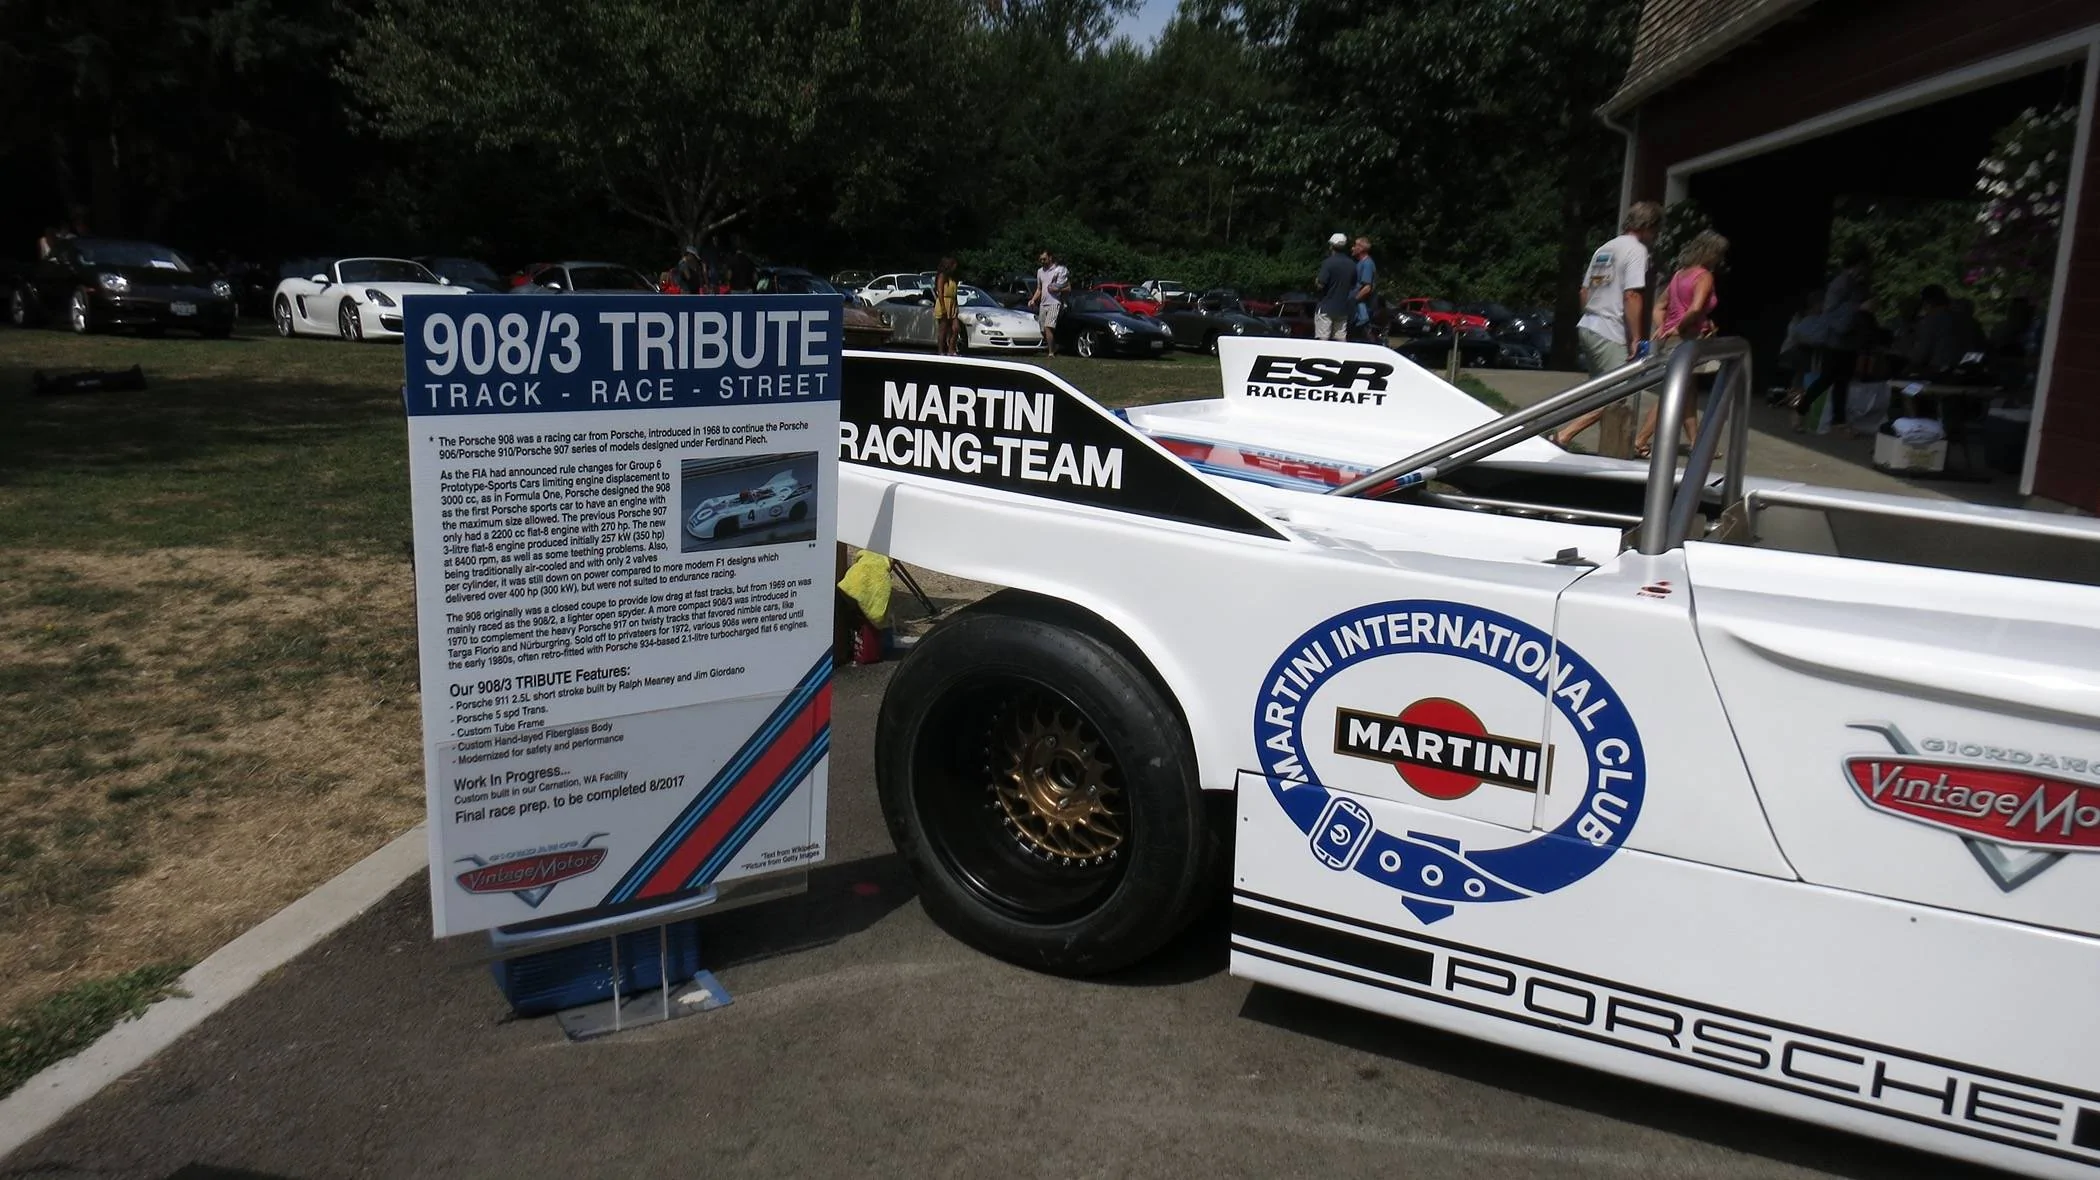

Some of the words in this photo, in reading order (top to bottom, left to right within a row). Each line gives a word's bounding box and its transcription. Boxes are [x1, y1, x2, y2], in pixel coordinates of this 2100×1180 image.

[423, 310, 582, 376] 908/3
[599, 310, 830, 371] TRIBUTE
[1247, 355, 1394, 391] ESR
[425, 381, 542, 408] TRACK
[591, 378, 675, 404] RACE
[718, 373, 830, 399] STREET
[1246, 384, 1387, 405] RACECRAFT
[883, 380, 1054, 434] MARTINI
[438, 437, 457, 447] The
[458, 435, 497, 447] Porsche
[497, 434, 515, 445] 908
[516, 435, 535, 444] was
[544, 432, 572, 443] racing
[572, 433, 587, 442] car
[588, 430, 609, 441] from
[648, 426, 692, 438] introduced
[692, 426, 701, 436] in
[702, 425, 721, 436] 1968
[722, 425, 731, 435] to
[731, 423, 765, 434] continue
[765, 422, 778, 432] the
[779, 421, 809, 431] Porsche
[439, 448, 496, 460] 906/Porsche
[497, 445, 552, 458] 910/Porsche
[553, 444, 570, 455] 907
[571, 443, 597, 454] series
[598, 442, 608, 453] of
[609, 441, 640, 452] models
[641, 438, 679, 451] designed
[680, 437, 704, 449] under
[705, 435, 744, 447] Ferdinand
[508, 464, 558, 477] announced
[577, 463, 614, 474] changes
[838, 421, 1123, 490] RACING-TEAM
[440, 479, 518, 494] Prototype-Sports
[542, 476, 574, 488] limiting
[575, 474, 605, 486] engine
[605, 471, 661, 484] displacement
[504, 490, 541, 502] Formula
[564, 487, 600, 498] Porsche
[601, 484, 640, 496] designed
[459, 518, 503, 529] maximum
[580, 510, 616, 523] previous
[617, 507, 651, 519] Porsche
[491, 503, 528, 515] Porsche
[529, 502, 558, 514] sports
[619, 495, 648, 507] engine
[443, 545, 470, 555] 3-litre
[471, 542, 494, 553] flat-8
[495, 540, 526, 553] engine
[527, 536, 569, 551] produced
[569, 535, 600, 546] initially
[527, 526, 549, 537] flat-8
[550, 524, 580, 536] engine
[471, 564, 523, 577] traditionally
[524, 560, 568, 573] air-cooled
[632, 553, 658, 564] valves
[570, 546, 605, 558] teething
[610, 564, 652, 578] compared
[684, 559, 715, 571] modern
[726, 555, 756, 566] designs
[445, 591, 487, 604] delivered
[633, 575, 658, 587] suited
[669, 572, 710, 583] endurance
[446, 623, 477, 635] mainly
[567, 612, 594, 624] lighter
[678, 599, 711, 612] compact
[750, 589, 789, 603] introduced
[483, 607, 523, 620] originally
[551, 601, 580, 613] closed
[618, 595, 649, 607] provide
[480, 629, 534, 644] complement
[578, 621, 612, 633] Porsche
[707, 606, 736, 619] favored
[617, 628, 658, 641] privateers
[692, 621, 721, 631] various
[760, 611, 788, 623] entered
[541, 645, 585, 660] retro-fitted
[605, 640, 638, 653] Porsche
[639, 634, 681, 649] 934-based
[681, 632, 709, 644] 2.1-litre
[449, 683, 475, 698] Our
[477, 677, 512, 694] 908/3
[515, 670, 572, 689] TRIBUTE
[575, 666, 630, 682] Features:
[456, 698, 493, 711] Porsche
[494, 695, 509, 706] 911
[511, 692, 531, 704] 2.5L
[532, 689, 556, 701] short
[558, 686, 585, 698] stroke
[586, 683, 605, 695] built
[606, 682, 617, 693] by
[618, 678, 643, 690] Ralph
[676, 671, 692, 683] and
[693, 670, 708, 681] Jim
[709, 666, 745, 678] Giordano
[456, 711, 494, 724] Porsche
[495, 709, 502, 719] 5
[503, 707, 520, 720] spd
[457, 726, 492, 738] Custom
[493, 722, 516, 733] Tube
[517, 719, 545, 730] Frame
[1266, 641, 1332, 792] MARTINI
[1329, 612, 1607, 731] INTERNATIONAL
[1575, 737, 1632, 846] CLUB
[457, 737, 493, 752] Custom
[494, 730, 544, 747] Hand-layed
[545, 726, 590, 740] Fiberglass
[591, 721, 613, 733] Body
[458, 748, 510, 765] Modernized
[511, 747, 525, 757] for
[526, 743, 553, 756] safety
[553, 740, 570, 752] and
[571, 734, 624, 750] performance
[1348, 718, 1538, 782] MARTINI
[453, 775, 487, 792] Work
[490, 774, 502, 787] In
[454, 793, 489, 806] Custom
[490, 788, 510, 800] built
[511, 787, 520, 796] in
[521, 785, 537, 795] our
[583, 774, 598, 785] WA
[599, 770, 629, 783] Facility
[455, 807, 486, 824] Final
[489, 805, 516, 819] race
[553, 796, 565, 808] to
[568, 793, 584, 806] be
[586, 780, 647, 802] completed
[649, 774, 685, 792] 8/2017
[1445, 956, 2064, 1142] PORSCHE
